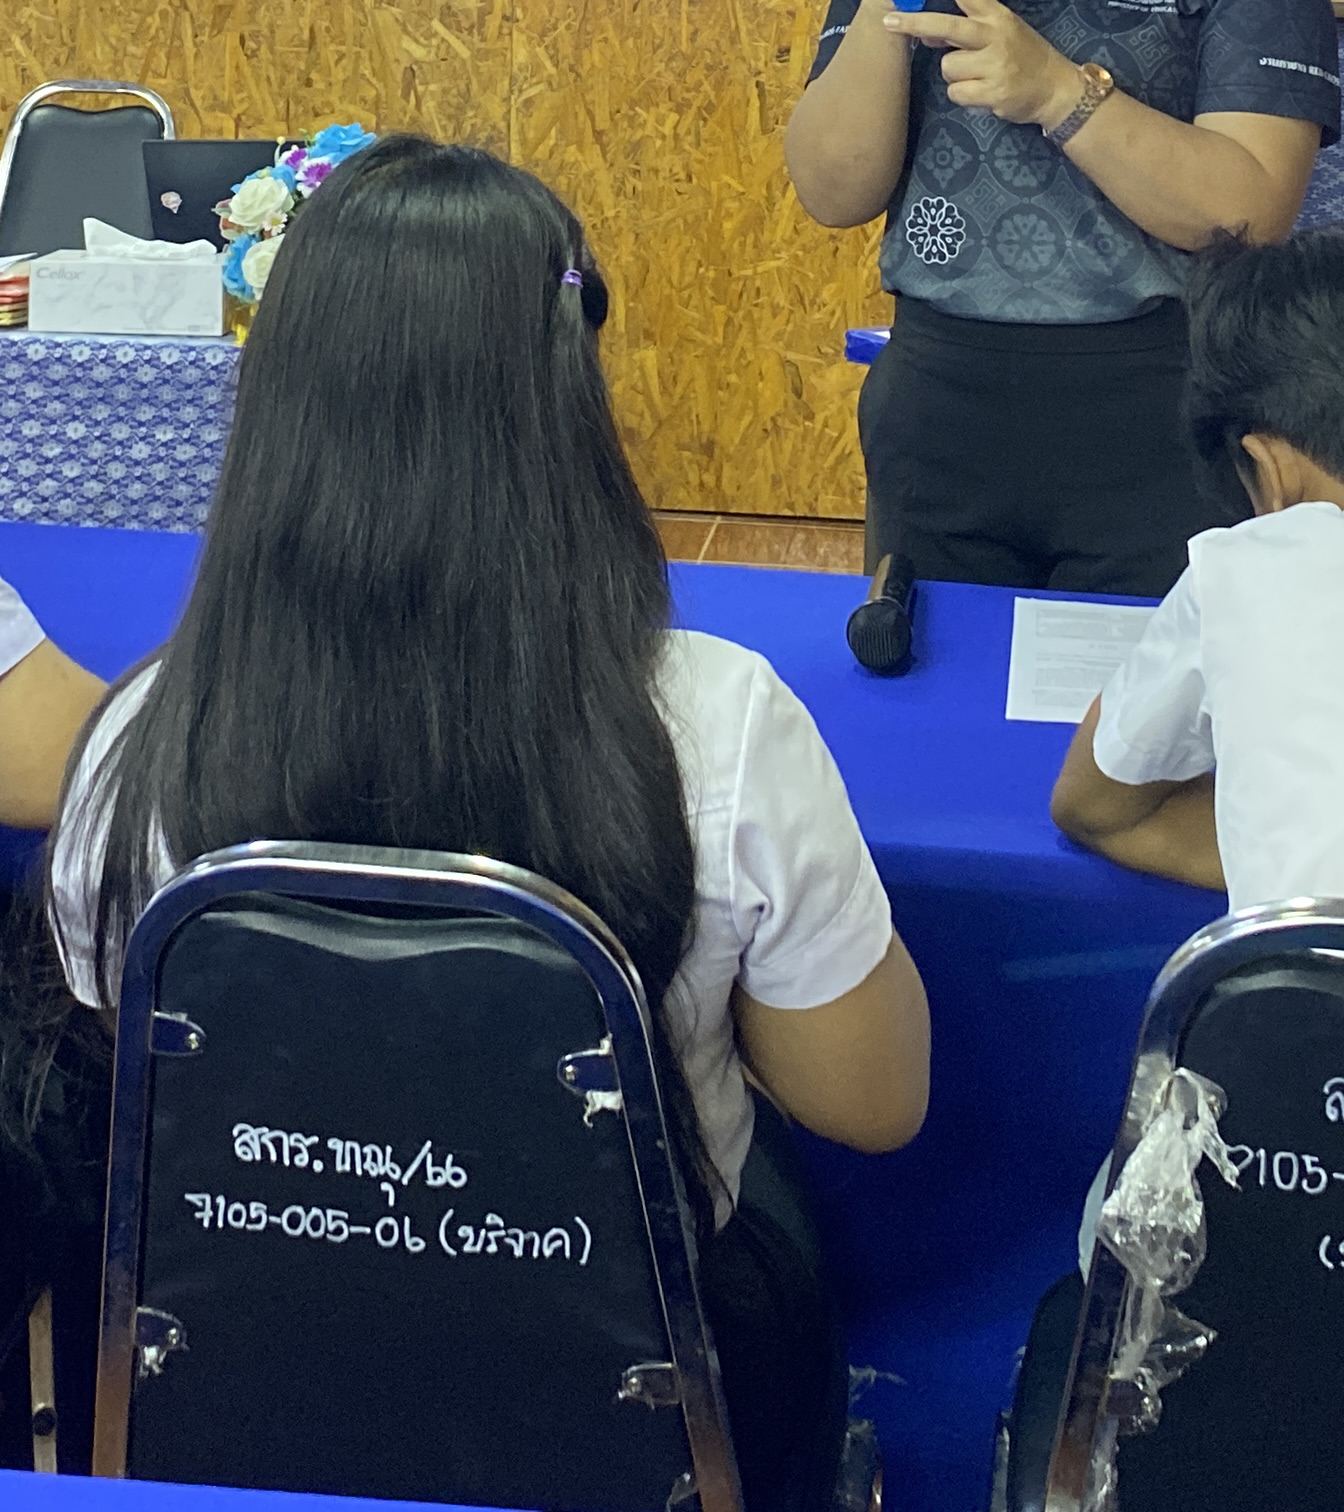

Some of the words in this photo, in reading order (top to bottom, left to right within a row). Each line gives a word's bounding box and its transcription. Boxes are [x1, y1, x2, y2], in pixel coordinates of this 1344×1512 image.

[35, 266, 84, 281] Cellox
[184, 1191, 427, 1254] 7105-005-06
[439, 1207, 593, 1266] (บริจาค)
